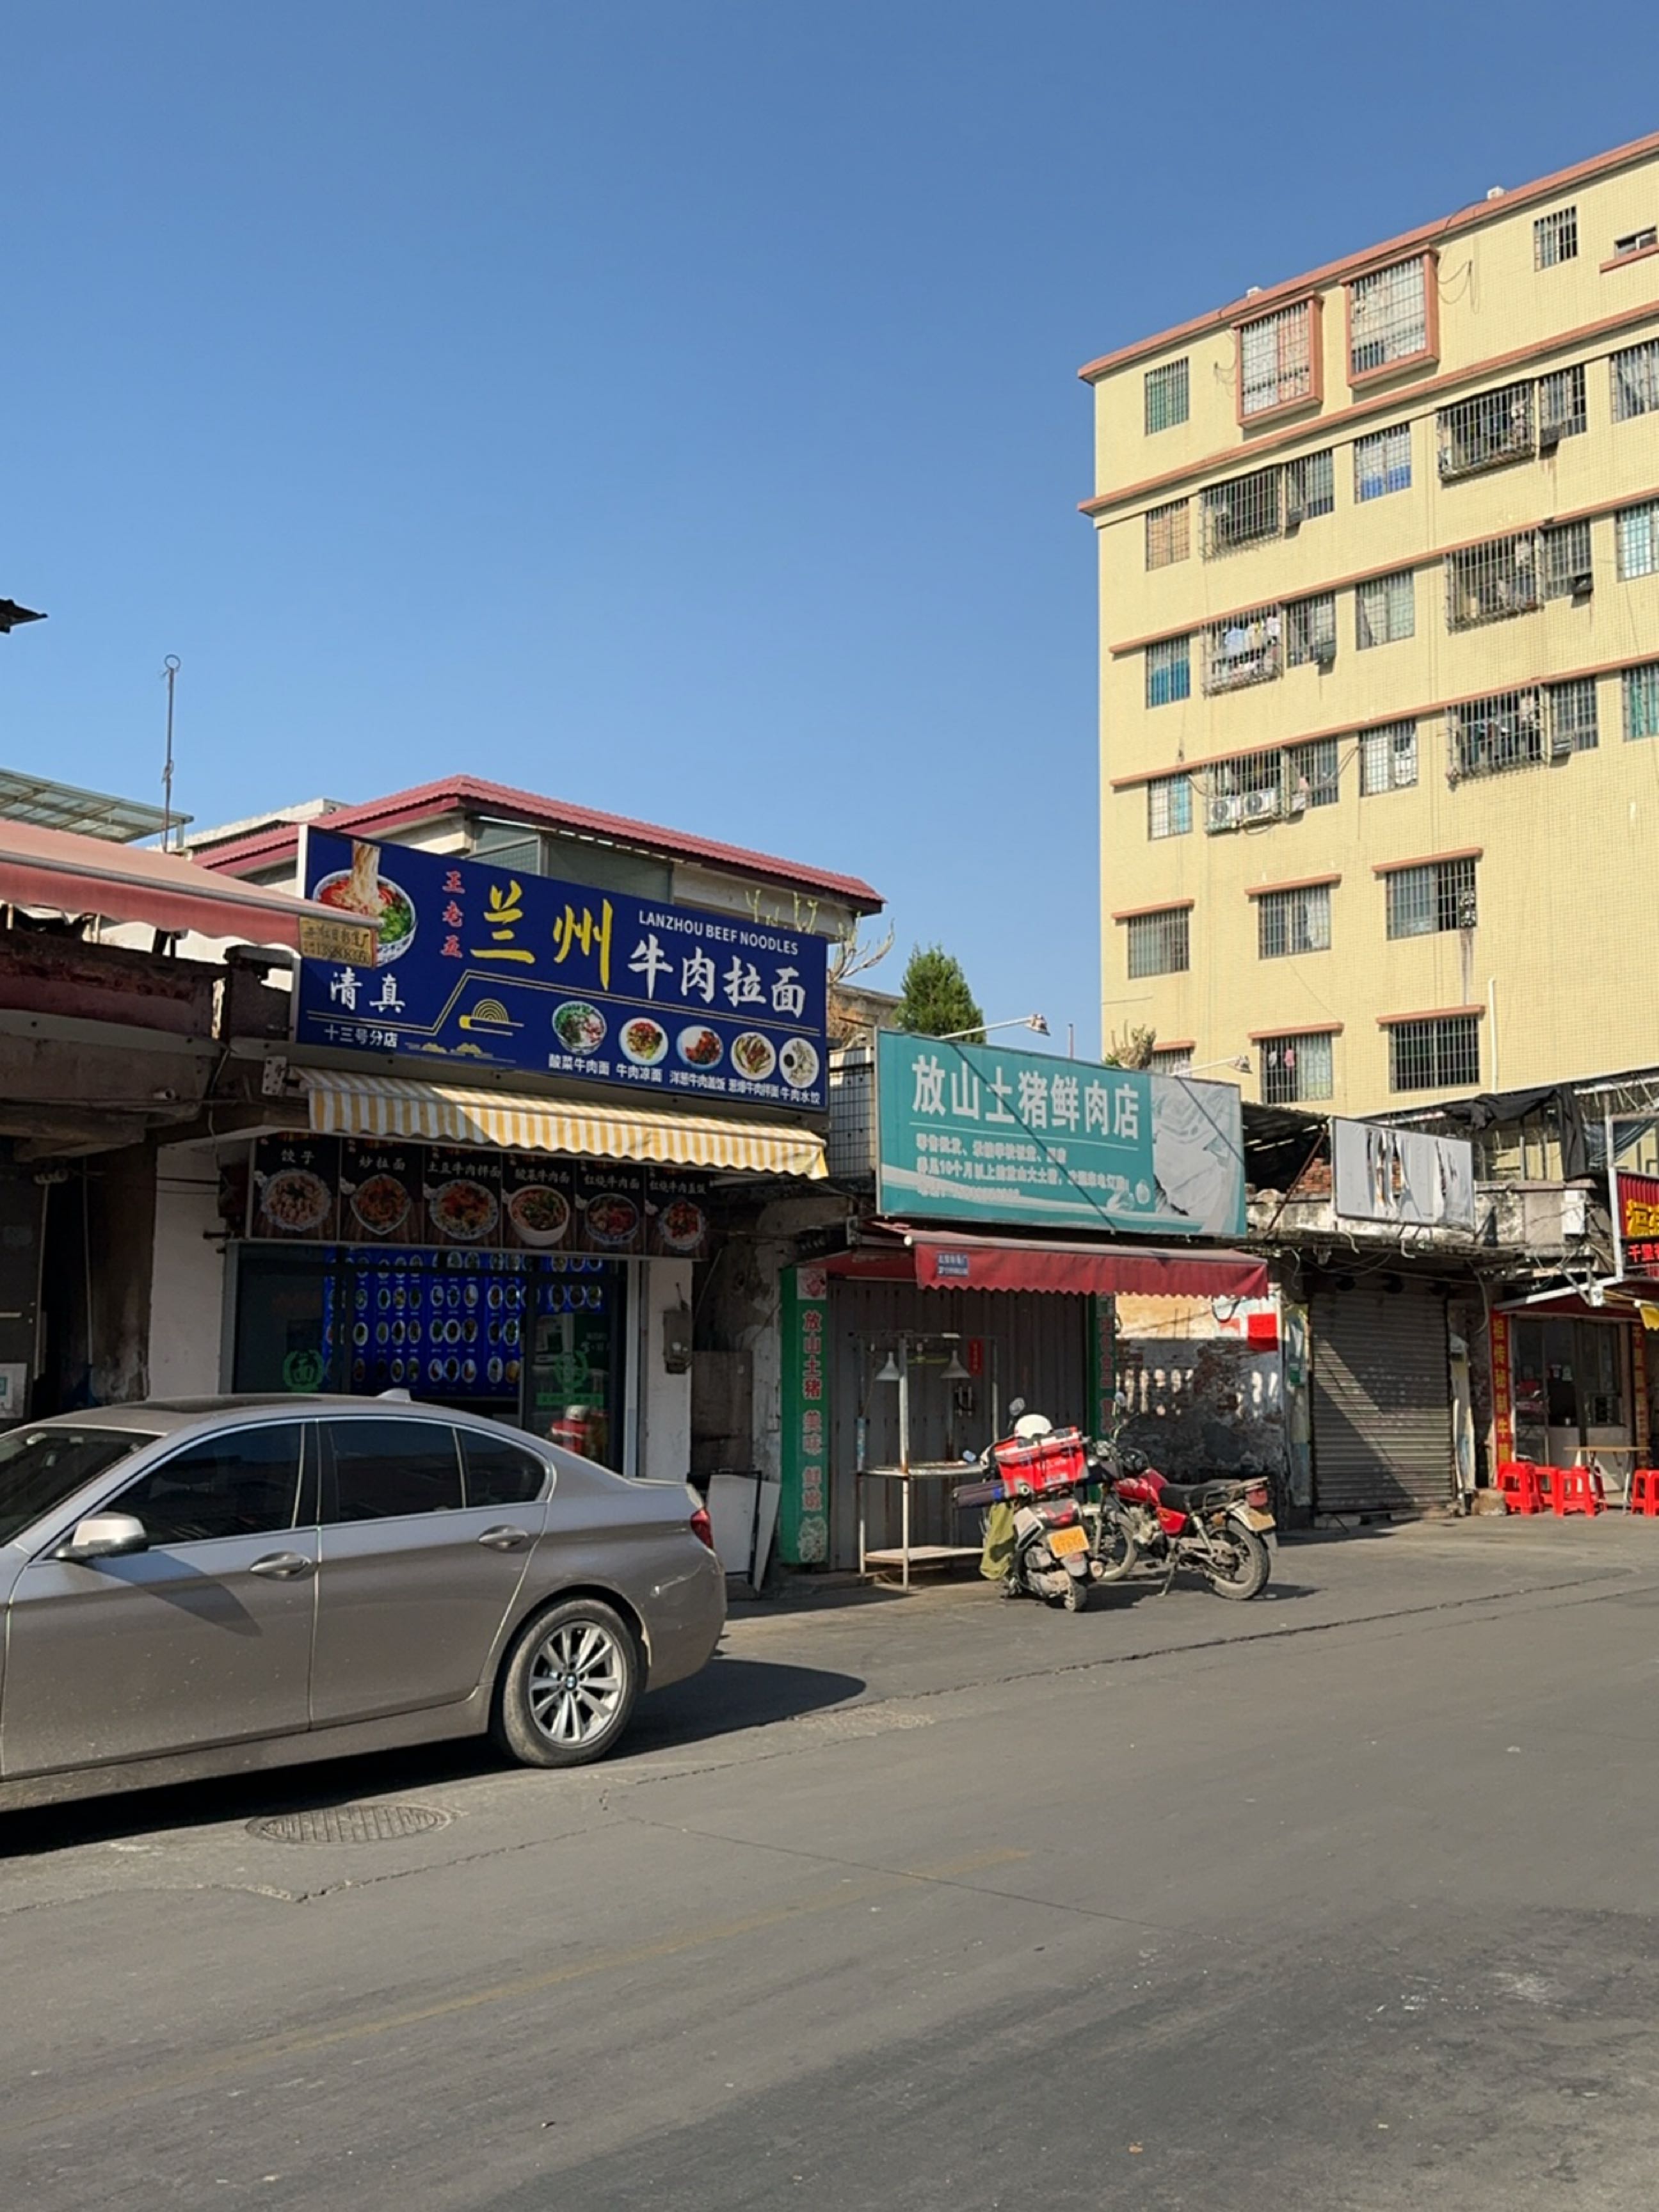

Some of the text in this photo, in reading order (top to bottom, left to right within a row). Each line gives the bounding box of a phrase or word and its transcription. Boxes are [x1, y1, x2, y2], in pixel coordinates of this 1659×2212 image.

[639, 910, 799, 956] LANZHOU BEEF NOODLES
[330, 967, 406, 1013] 清真
[325, 1025, 397, 1048] 十三号分店
[549, 1054, 610, 1076] 酸菜牛肉面
[780, 1087, 821, 1105] 牛肉水饺
[911, 1055, 1139, 1139] 放山土猪鲜肉店
[802, 1309, 822, 1400] 放山土猪
